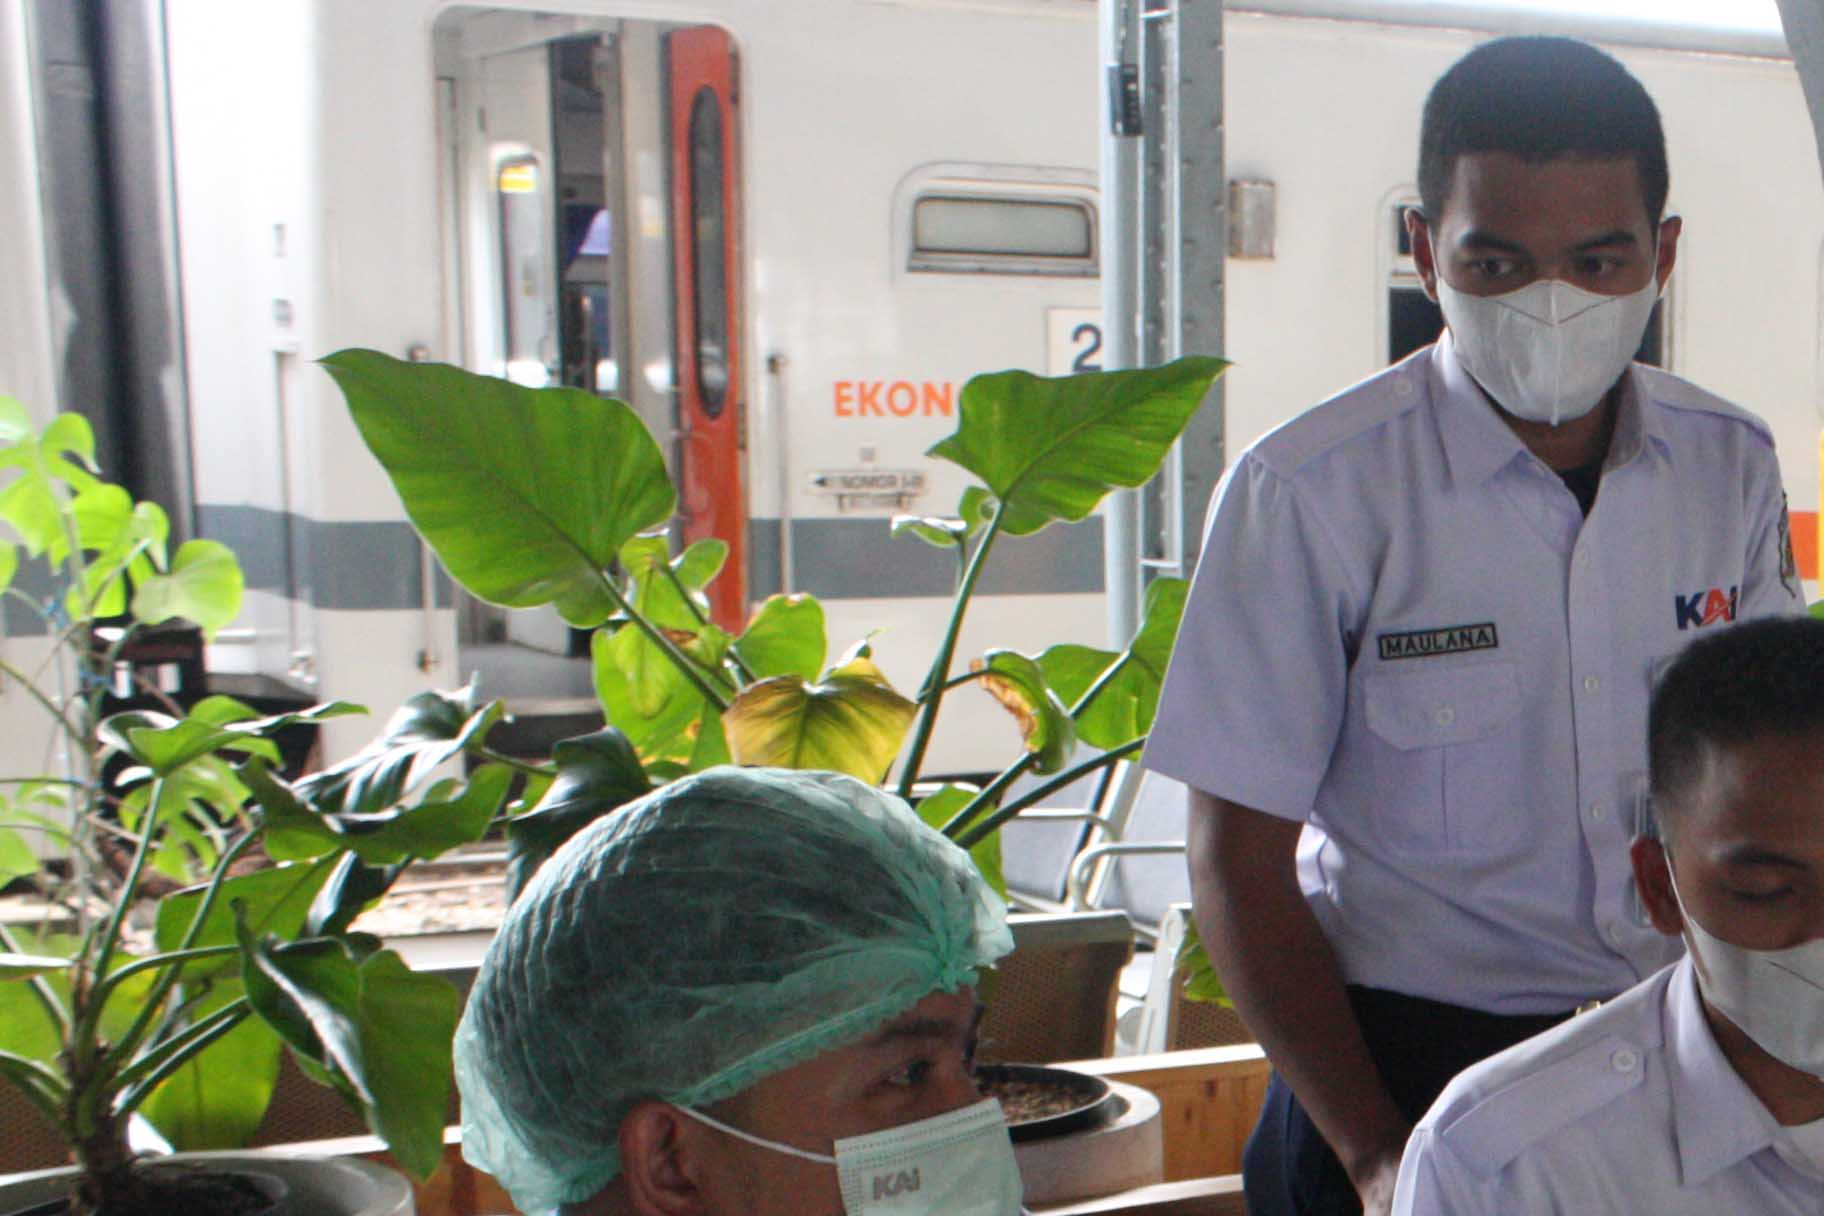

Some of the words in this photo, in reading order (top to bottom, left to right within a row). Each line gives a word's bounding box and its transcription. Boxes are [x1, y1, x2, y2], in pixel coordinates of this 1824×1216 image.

[1071, 322, 1103, 374] 2
[833, 380, 954, 417] EKON
[1675, 585, 1738, 631] KAI
[1386, 628, 1491, 655] MAULANA
[872, 1166, 921, 1201] KAI
